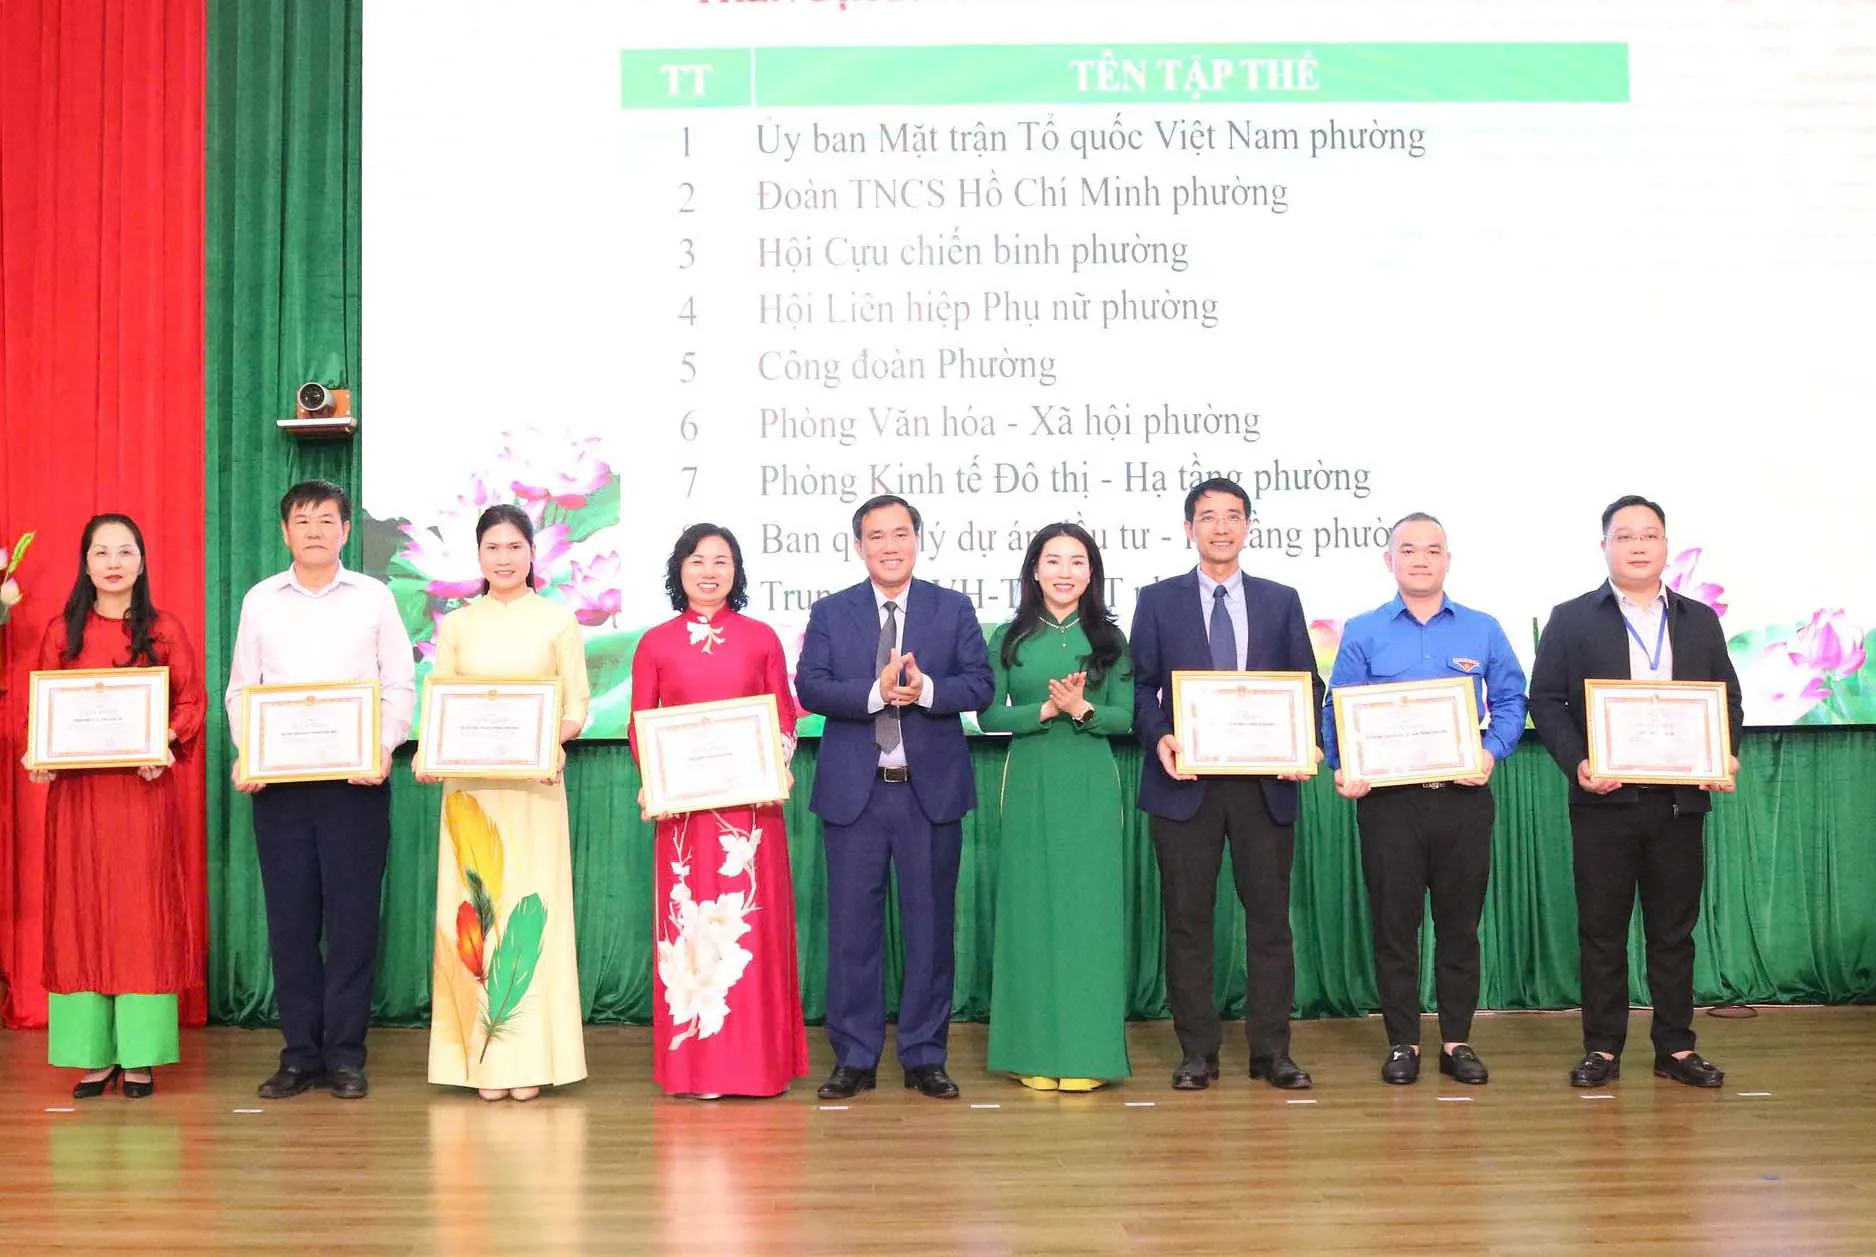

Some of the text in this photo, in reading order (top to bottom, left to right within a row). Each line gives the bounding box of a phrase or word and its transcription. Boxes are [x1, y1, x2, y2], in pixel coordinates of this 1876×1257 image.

[658, 64, 714, 97] TT
[1069, 48, 1147, 92] TÊN
[1157, 53, 1233, 100] TẬP
[683, 126, 690, 157] 1
[812, 122, 866, 153] ban
[879, 122, 938, 159] Mặt
[949, 120, 1007, 158] trận
[1018, 112, 1060, 151] Tổ
[1071, 112, 1143, 160] quốc
[1154, 118, 1217, 157] Việt
[1226, 119, 1299, 150] Nam
[1310, 118, 1426, 159] phường
[679, 168, 1289, 216] 2 Đoàn TNCS Hồ Chí Minh phường
[679, 226, 1189, 274] 3 Hội Cựu chiến binh phường
[678, 288, 1219, 331] 4 Hội Liên hiệp Phụ nữ phường
[679, 347, 1057, 389] 5 Công đoàn Phường
[680, 411, 698, 441] 6
[760, 407, 857, 447] Phòng
[868, 407, 929, 437] Văn
[943, 405, 996, 437] hóa
[1030, 405, 1073, 436] Xã
[1084, 402, 1132, 442] hội
[1143, 402, 1261, 445] phường
[681, 466, 698, 499] 7
[760, 463, 858, 504] Phòng
[869, 461, 945, 495] Kinh
[955, 454, 983, 494] tế
[993, 461, 1039, 494] Đô
[1050, 460, 1089, 499] thị
[1124, 461, 1168, 499] Hạ
[1254, 458, 1371, 499] phường
[761, 522, 821, 555] Ban
[919, 520, 946, 562] lý
[959, 520, 998, 558] dự
[1120, 522, 1150, 550] tư
[1246, 509, 1303, 558] ầng
[1314, 516, 1390, 558] phườ
